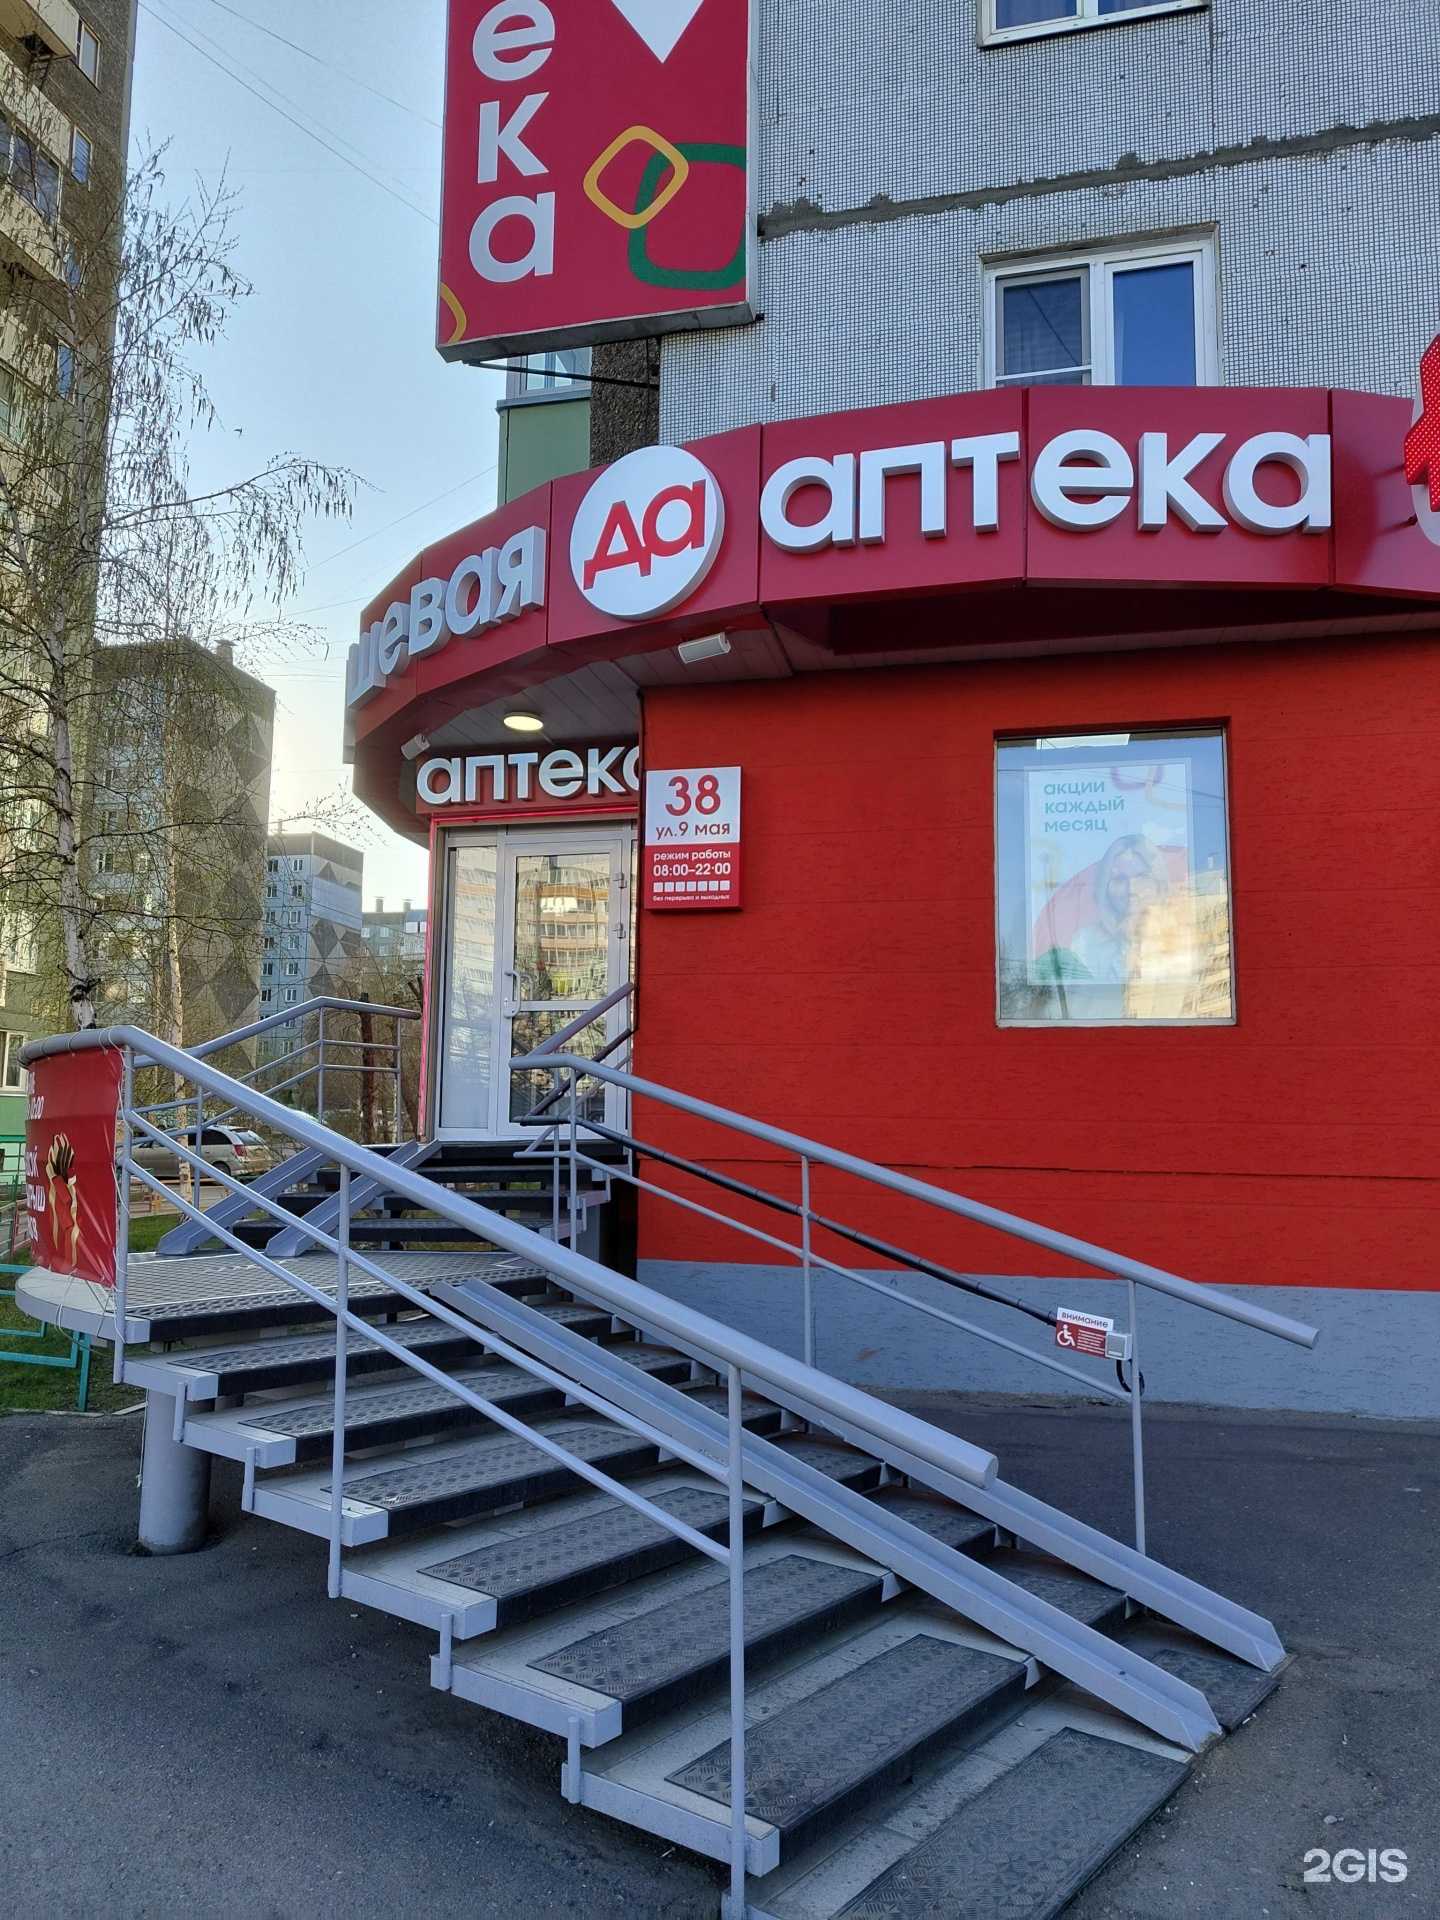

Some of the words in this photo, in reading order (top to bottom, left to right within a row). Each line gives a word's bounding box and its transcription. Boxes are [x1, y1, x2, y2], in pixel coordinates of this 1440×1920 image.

[760, 429, 1333, 553] аптека
[665, 775, 721, 816] 38
[1043, 780, 1105, 796] акции
[1044, 796, 1125, 815] каждый
[695, 823, 731, 836] мая
[1044, 817, 1108, 833] месяц
[653, 851, 690, 861] режим
[691, 849, 731, 860] работы
[1061, 1311, 1109, 1329] внимание
